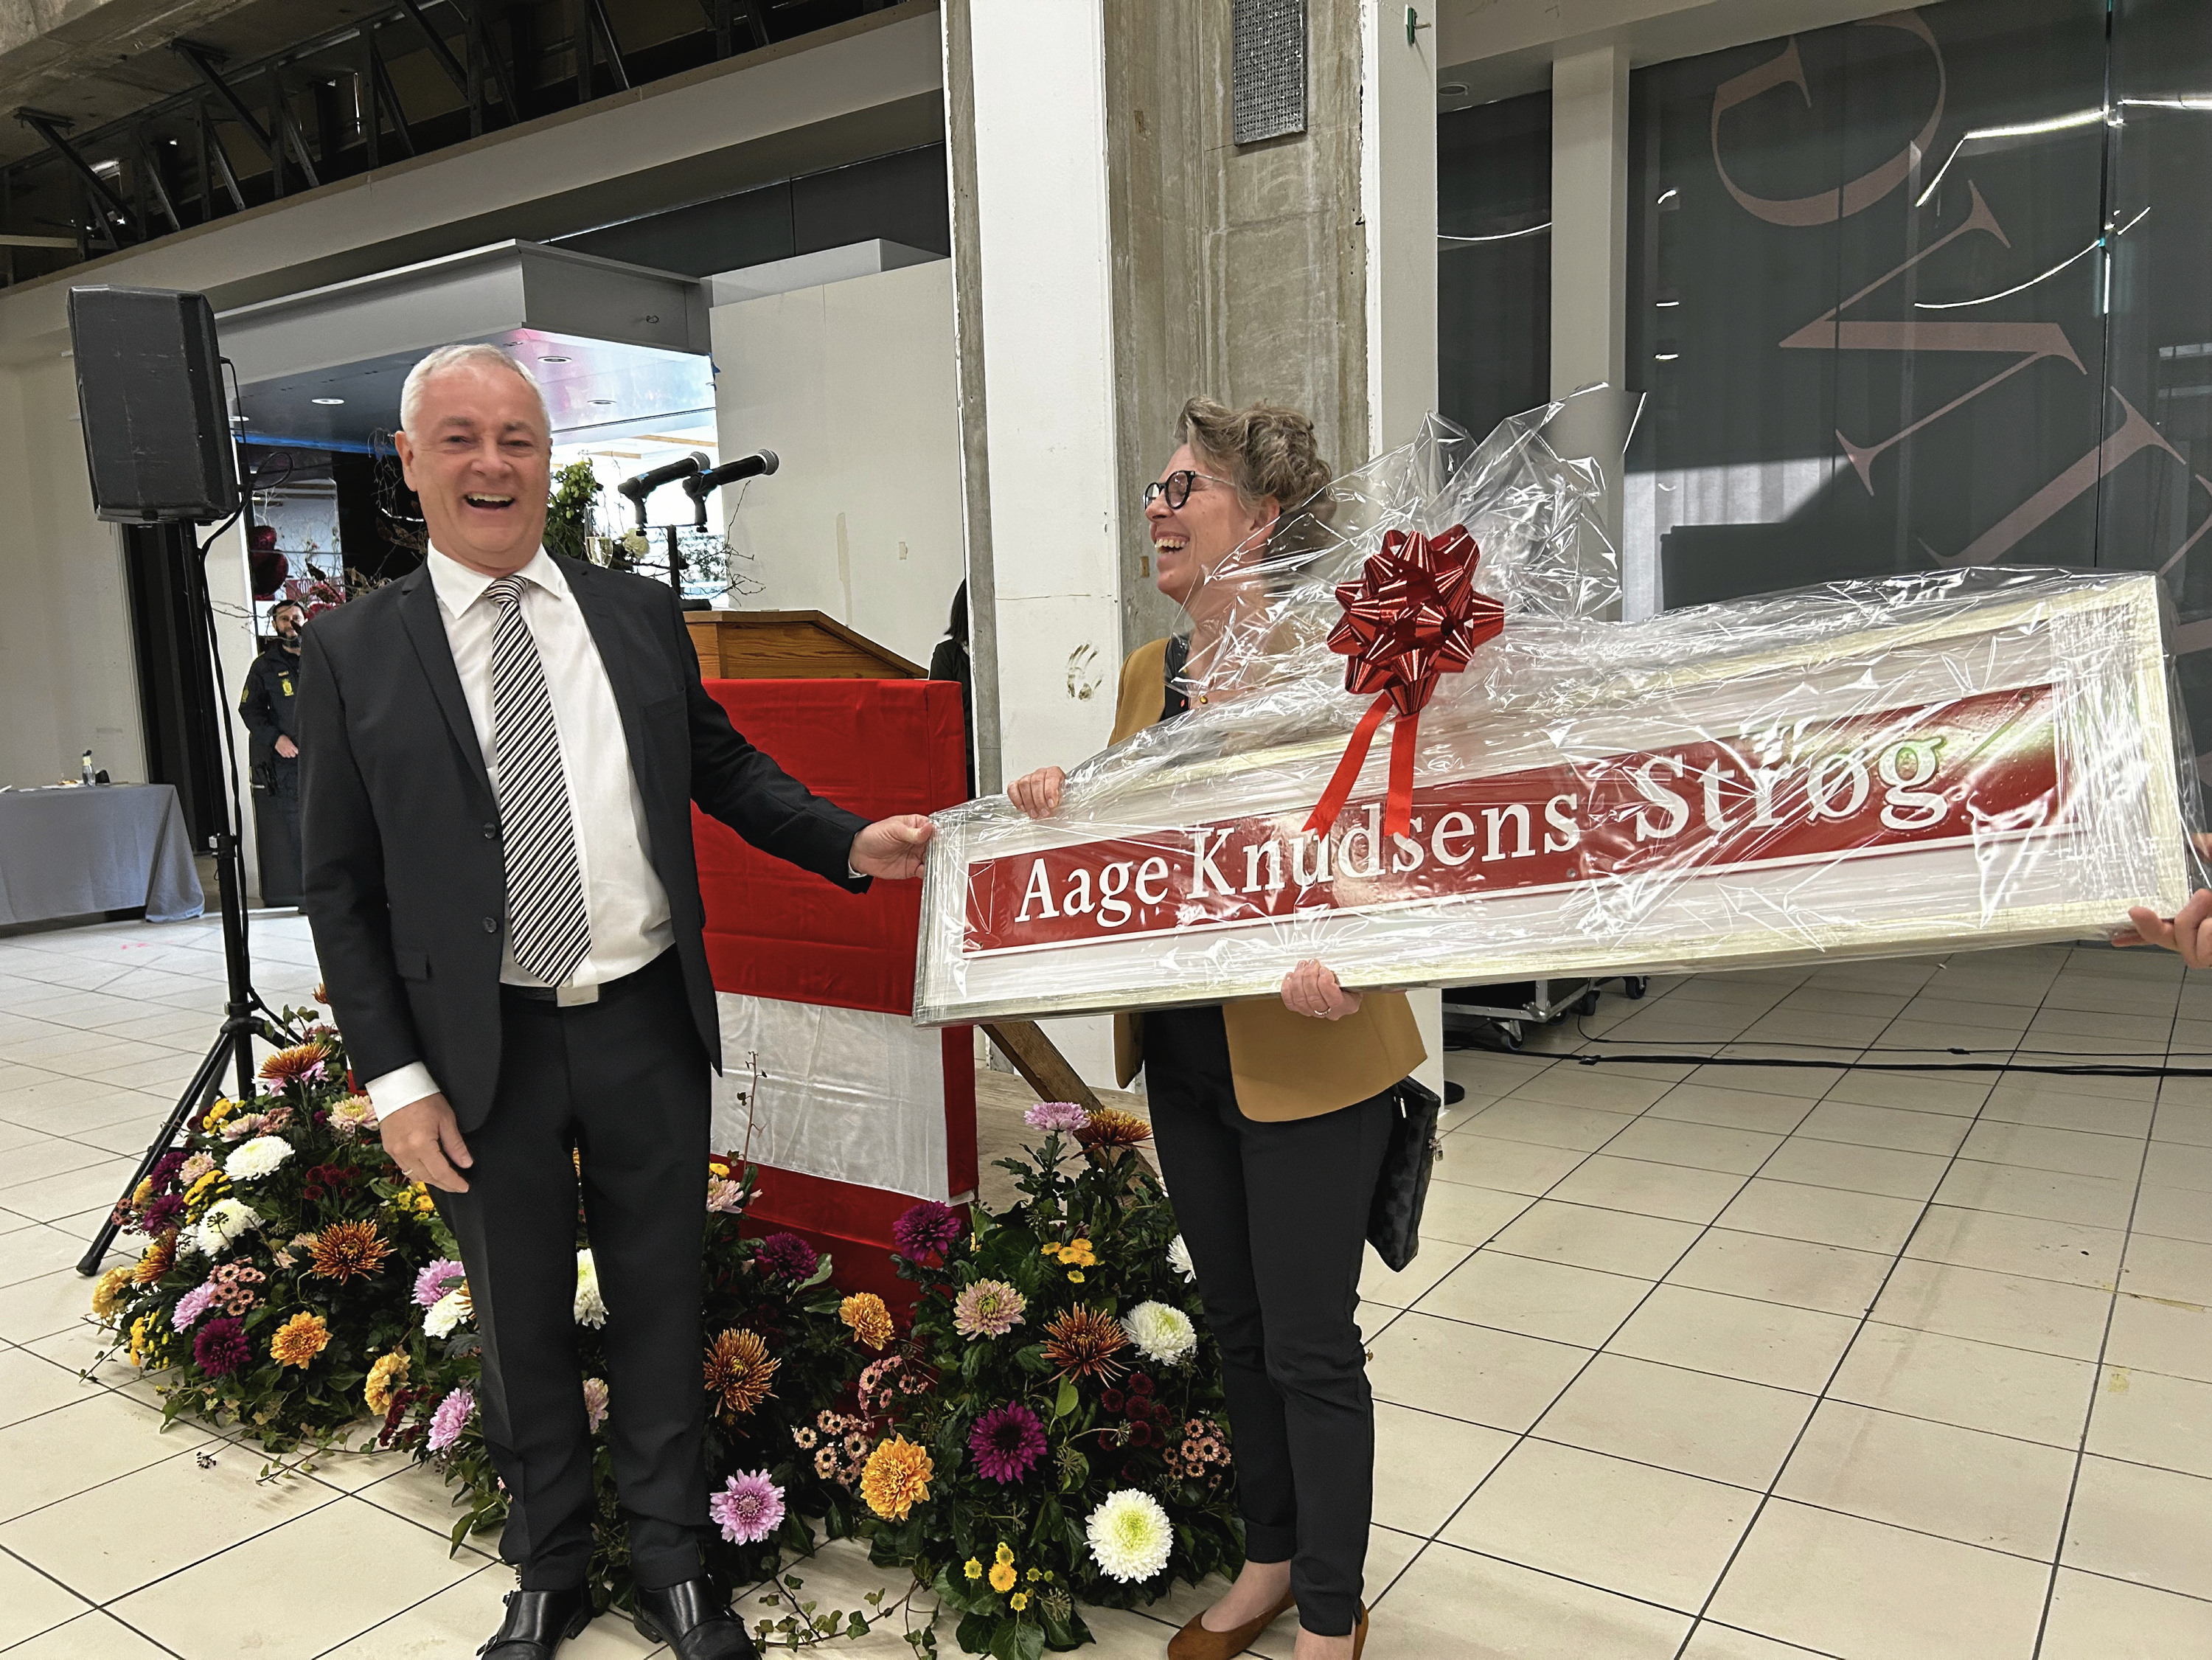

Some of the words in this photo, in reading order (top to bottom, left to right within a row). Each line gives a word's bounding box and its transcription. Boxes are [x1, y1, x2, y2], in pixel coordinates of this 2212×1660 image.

[1014, 857, 1169, 928] Aage
[1185, 792, 1581, 900] Knudsens
[1635, 737, 1949, 842] Strøg
